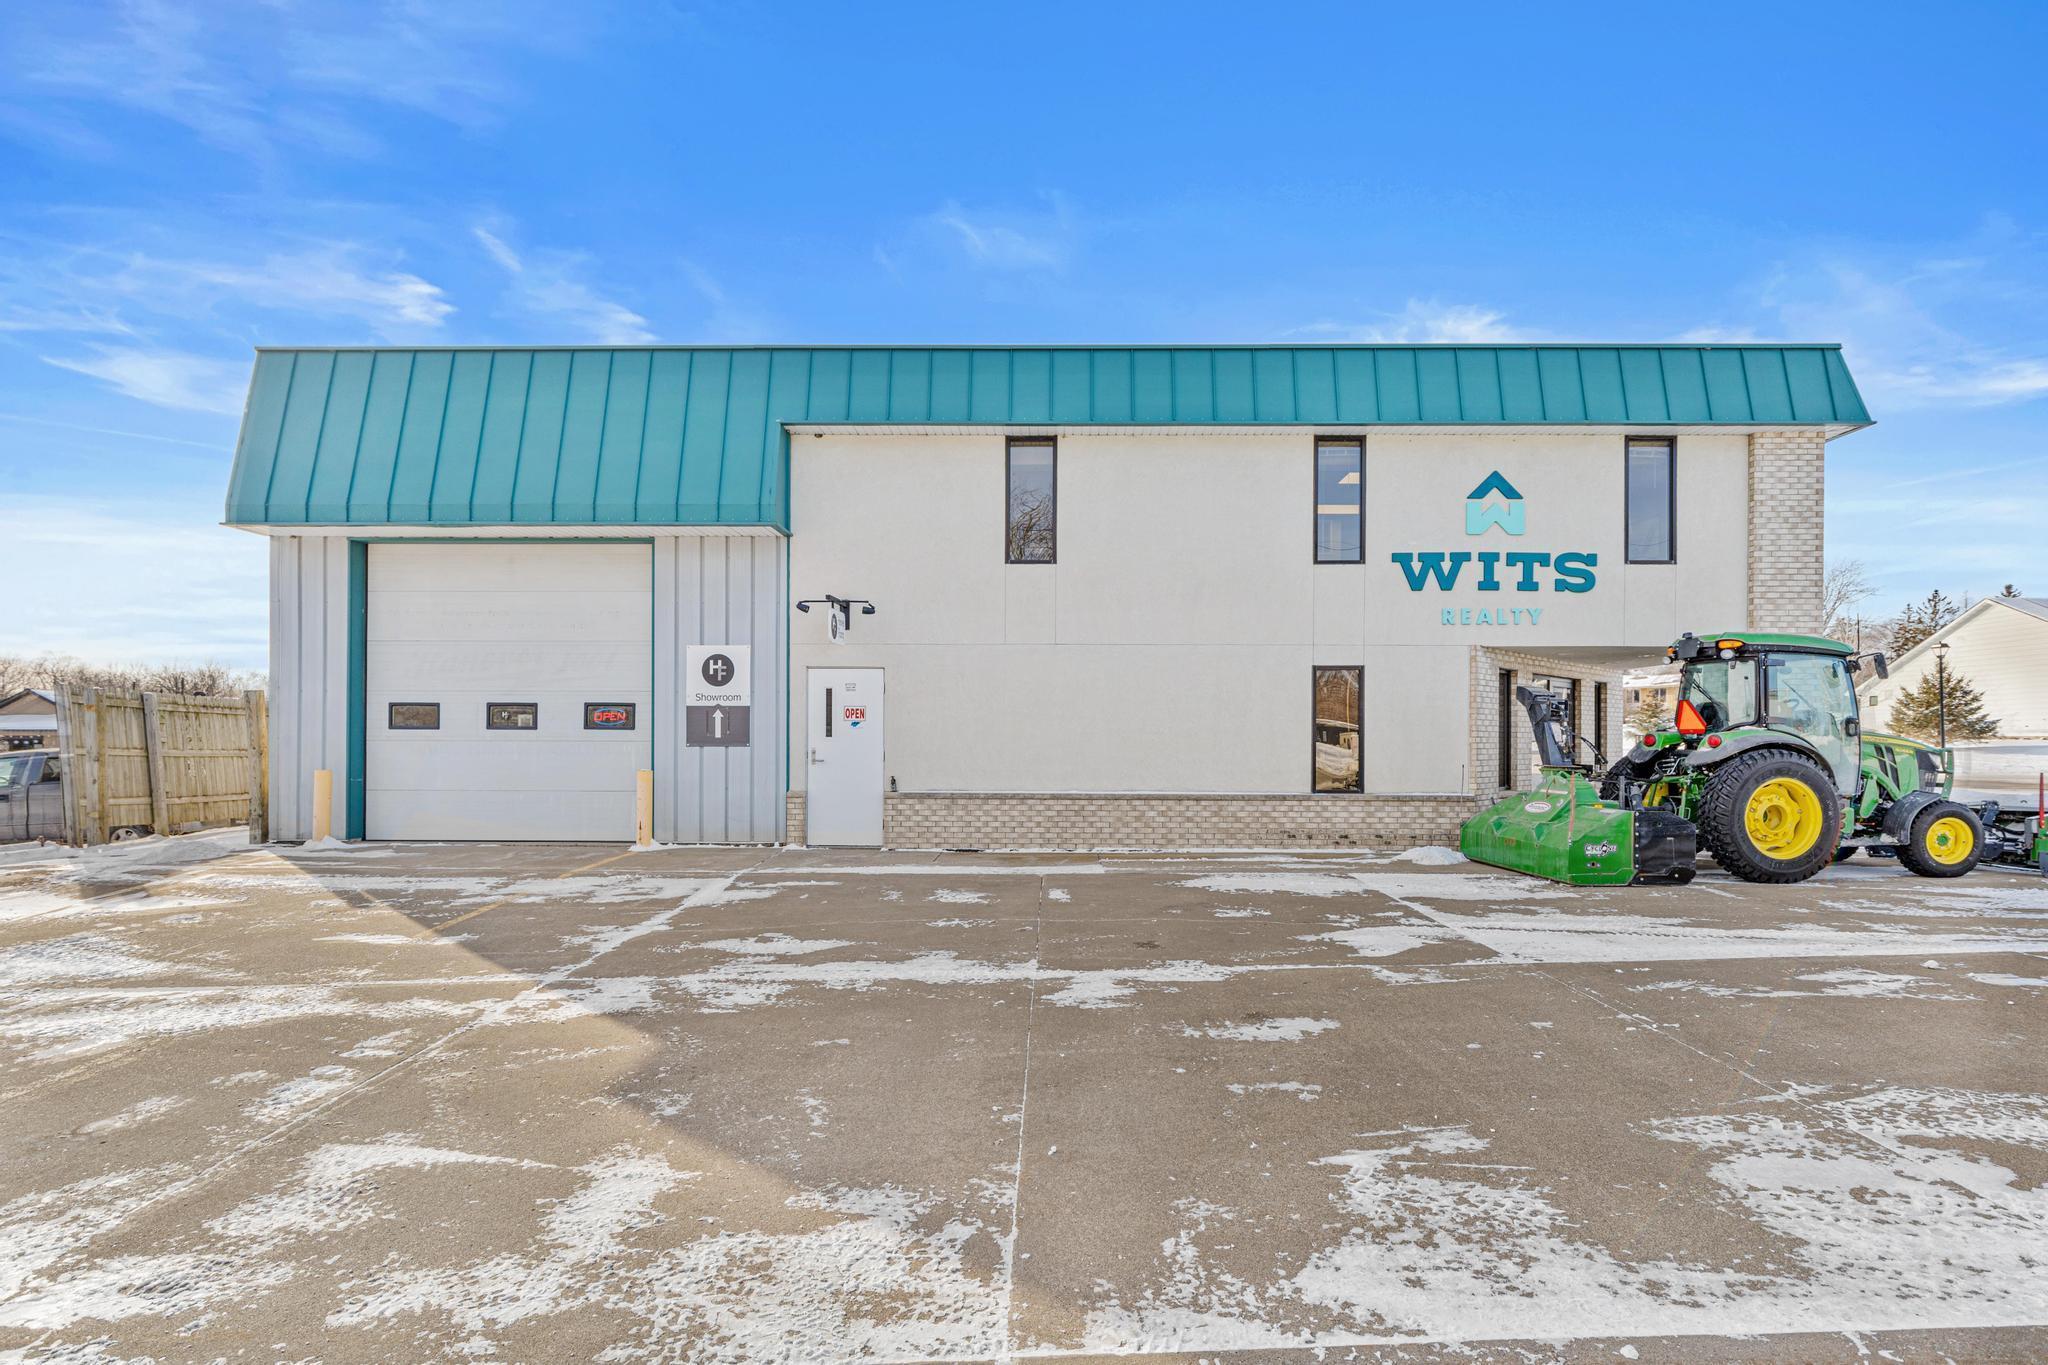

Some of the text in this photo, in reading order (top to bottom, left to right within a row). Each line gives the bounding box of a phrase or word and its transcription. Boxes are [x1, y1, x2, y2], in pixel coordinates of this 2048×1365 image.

[1391, 552, 1597, 593] WITS
[1441, 607, 1543, 625] REALTY
[695, 693, 742, 702] Showroom
[593, 711, 626, 722] OPEN
[845, 708, 865, 719] OPEN
